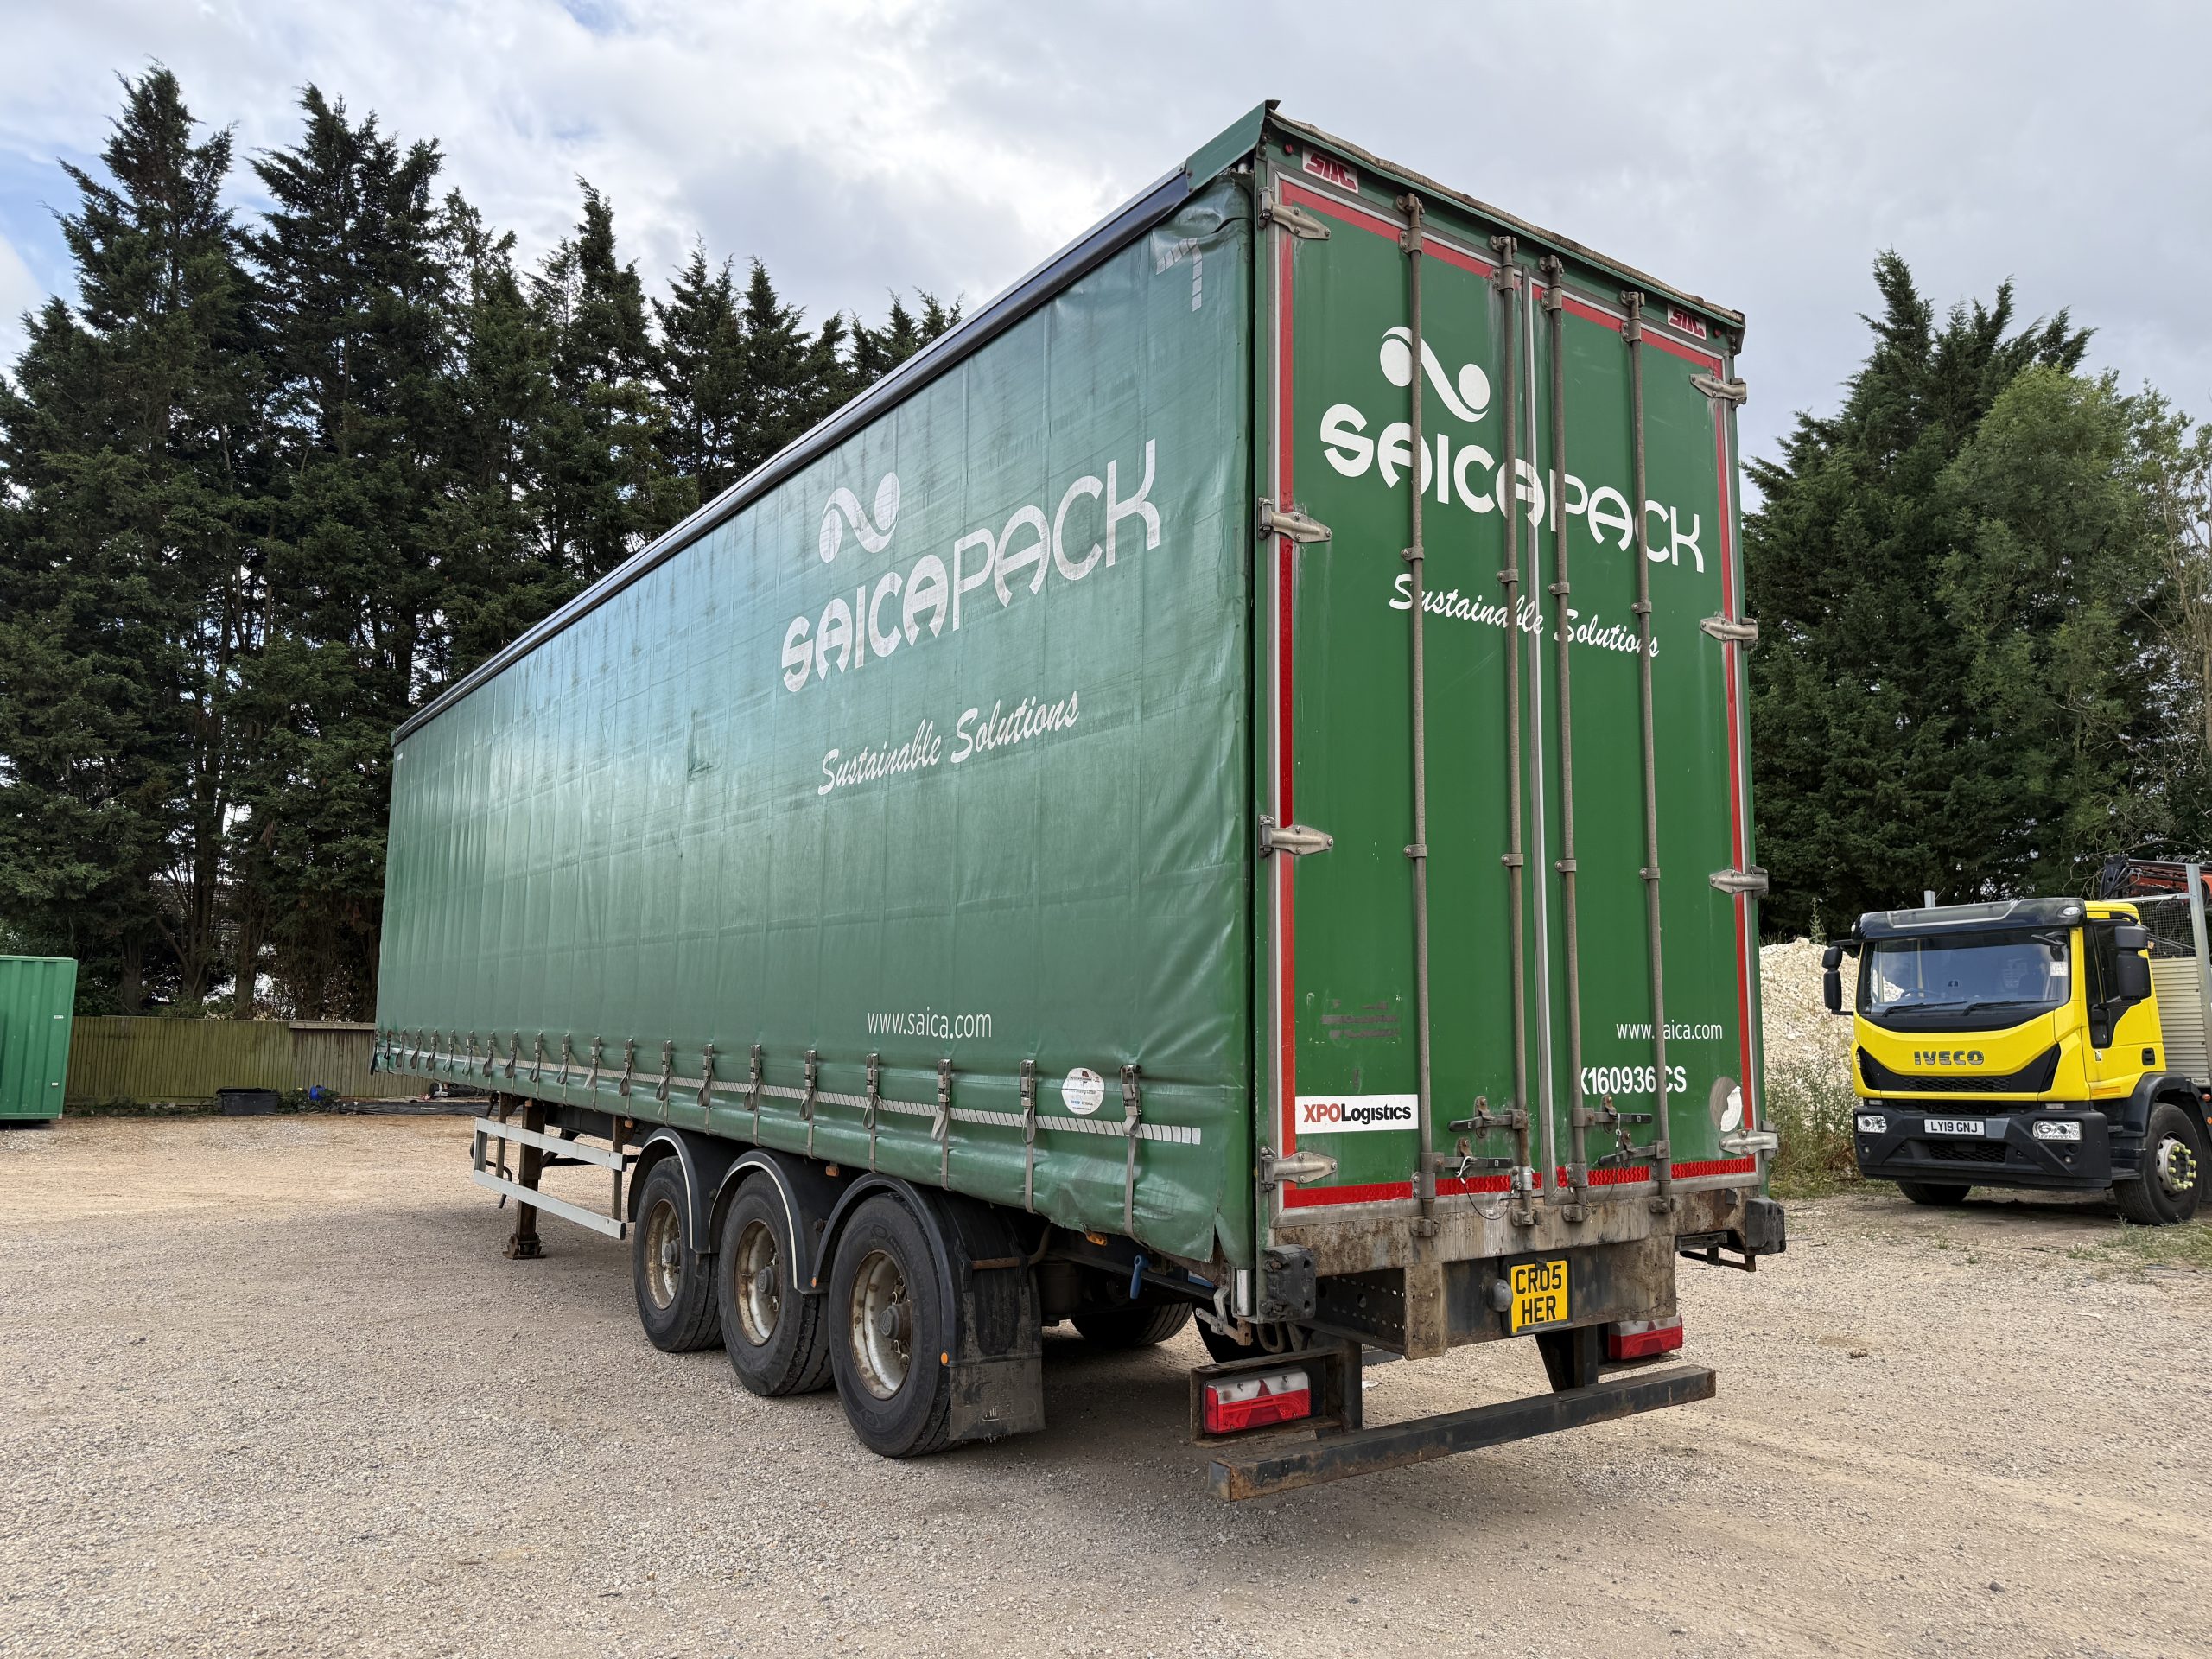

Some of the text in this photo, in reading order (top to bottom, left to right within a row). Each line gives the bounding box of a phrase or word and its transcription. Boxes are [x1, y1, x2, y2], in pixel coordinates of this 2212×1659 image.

[782, 438, 1160, 692] SAICAPACK
[817, 690, 1079, 795] Sustainable Solutions
[868, 1006, 992, 1039] www.saica.com
[1616, 1019, 1723, 1039] www.aica.com
[1914, 1050, 1985, 1065] IVECO
[1930, 1121, 1978, 1133] LY19 GNJ
[1516, 1264, 1562, 1295] CR05
[1522, 1295, 1557, 1325] HER
